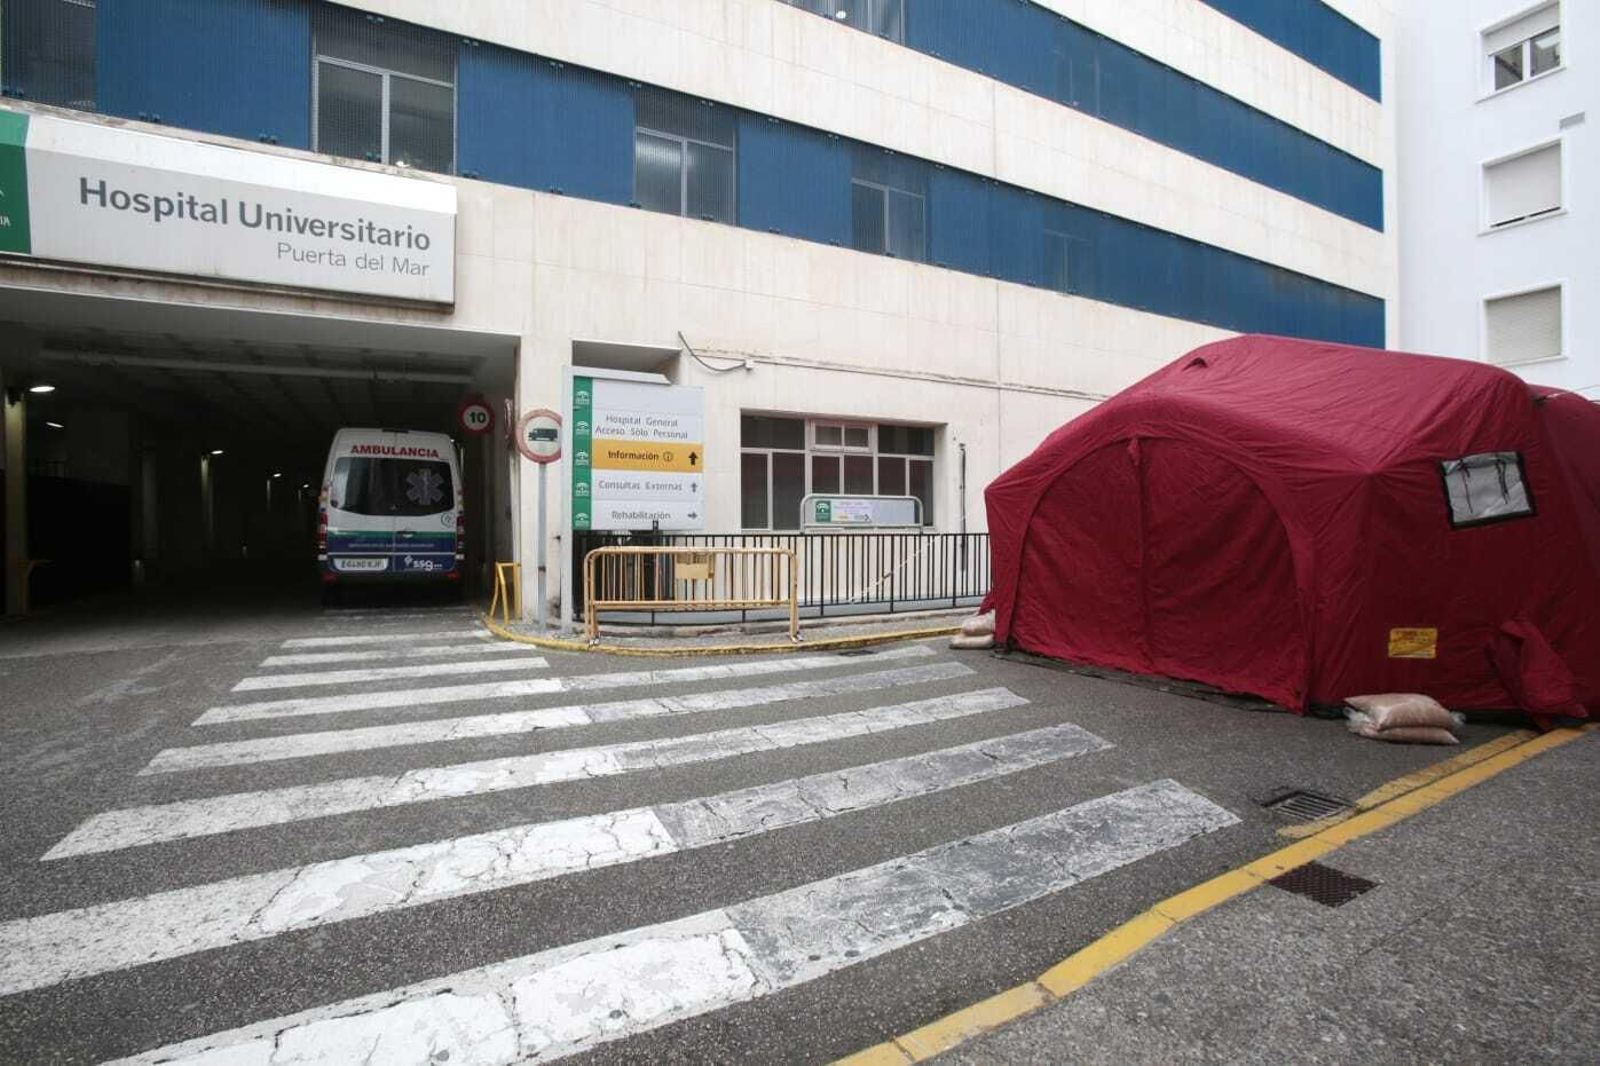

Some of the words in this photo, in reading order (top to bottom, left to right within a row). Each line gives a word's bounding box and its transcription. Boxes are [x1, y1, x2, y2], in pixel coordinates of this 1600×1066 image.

[80, 177, 228, 225] Hospital
[239, 202, 431, 251] Universitario
[277, 242, 347, 267] Puerta
[355, 252, 384, 272] del
[392, 256, 429, 276] Mar
[470, 411, 487, 424] 10
[606, 414, 641, 425] Hospital
[645, 416, 678, 427] General
[595, 425, 625, 435] Acceso
[653, 428, 688, 439] Personal
[350, 445, 440, 458] AMBULANCIA
[608, 450, 659, 461] Información
[598, 480, 640, 490] Consultas
[645, 482, 682, 491] Externas
